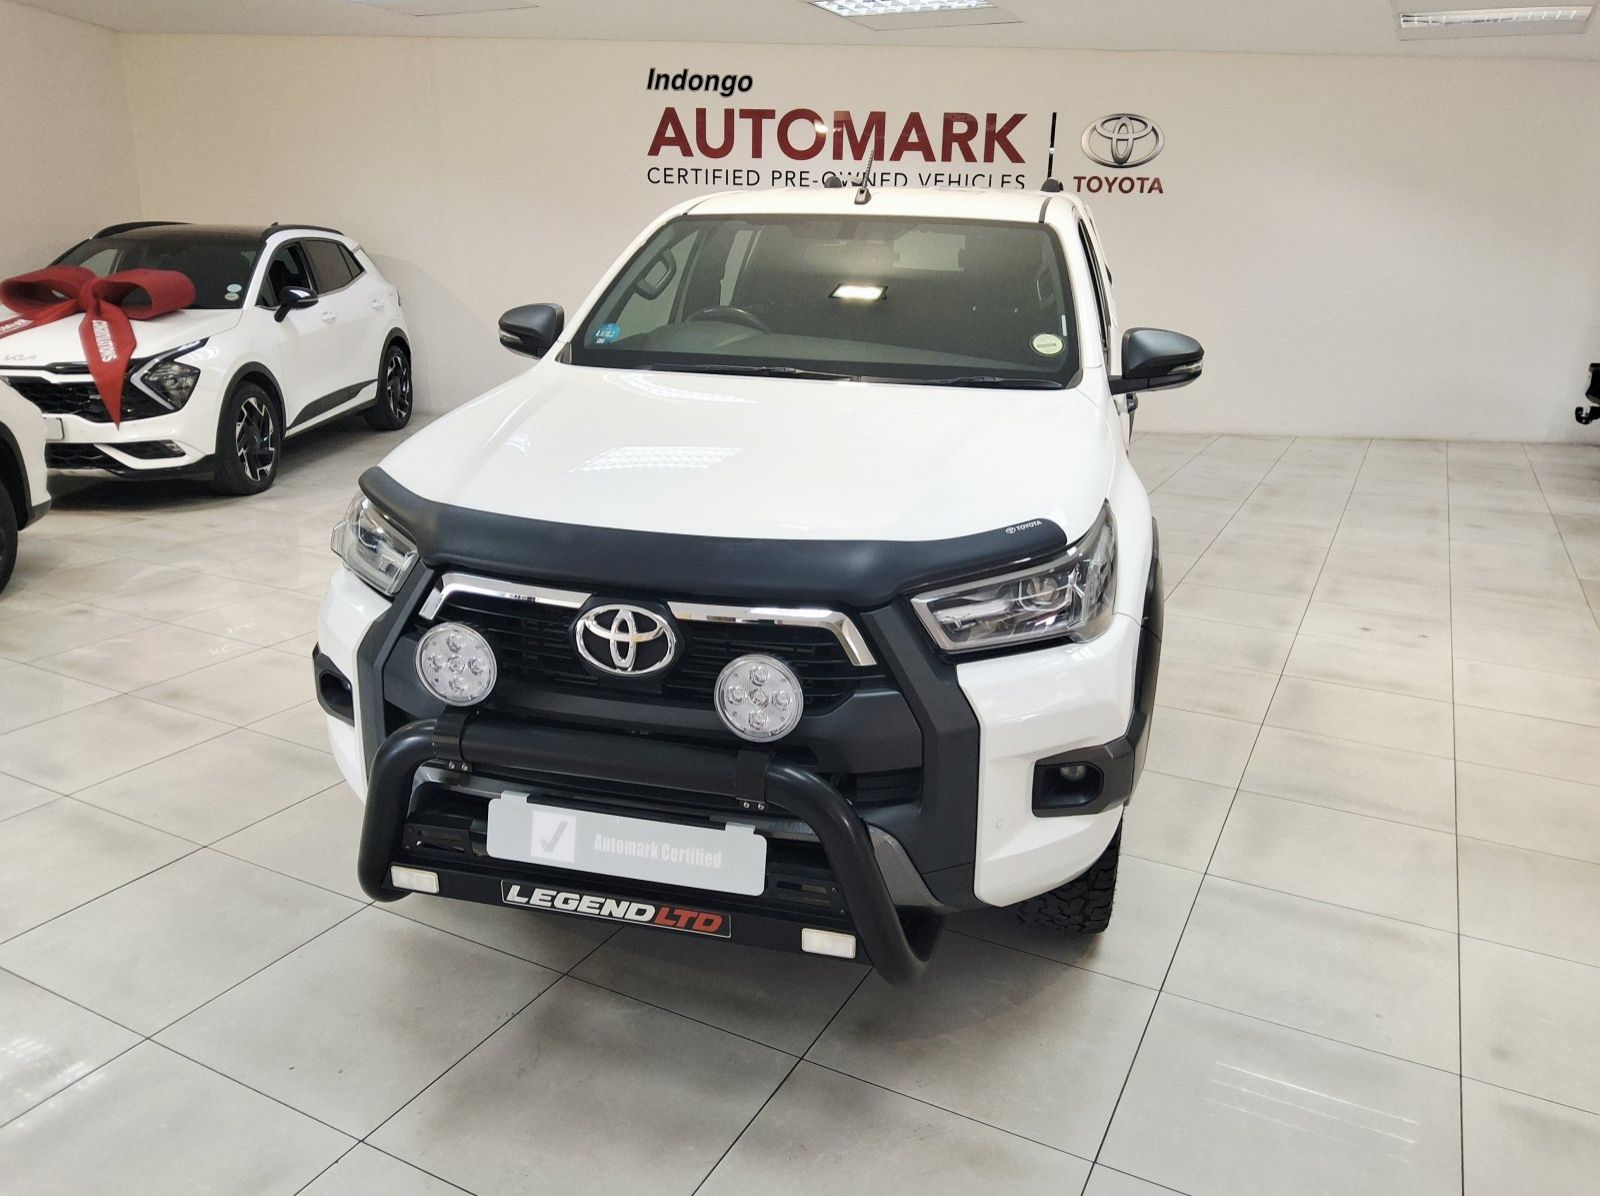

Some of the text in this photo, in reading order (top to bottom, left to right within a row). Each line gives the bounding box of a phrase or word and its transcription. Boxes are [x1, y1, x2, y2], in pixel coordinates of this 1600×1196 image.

[646, 68, 754, 97] Indongo
[647, 107, 1028, 164] AUTOMARK
[647, 167, 760, 186] CERTIFIED
[918, 173, 1026, 189] VEHICLES
[1073, 176, 1164, 194] TOYOTA
[1016, 520, 1042, 531] TOYOTA
[594, 833, 722, 868] Automark Certified
